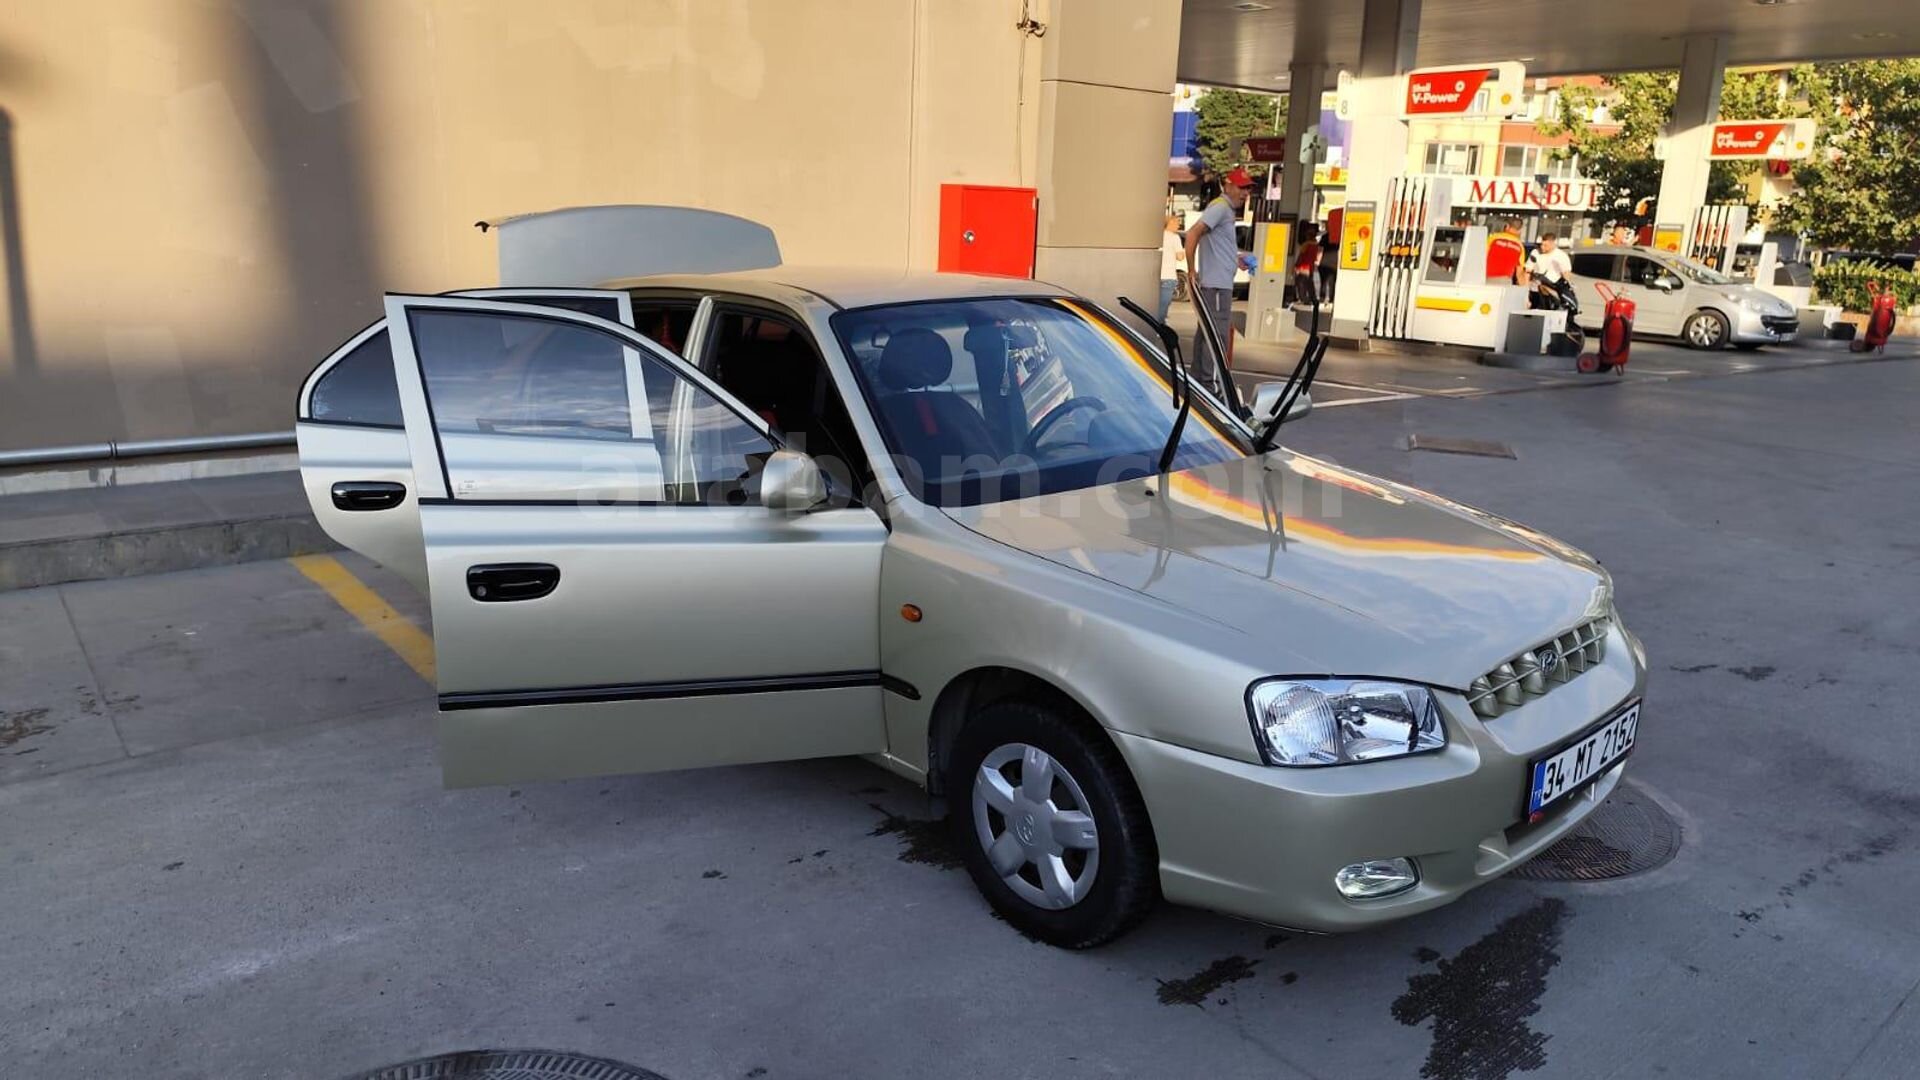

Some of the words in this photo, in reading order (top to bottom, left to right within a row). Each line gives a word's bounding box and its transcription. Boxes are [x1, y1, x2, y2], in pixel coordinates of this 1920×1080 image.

[1412, 92, 1461, 104] V-Power
[1543, 757, 1565, 800] 34
[1573, 737, 1597, 783] MT
[1600, 711, 1637, 765] 2152
